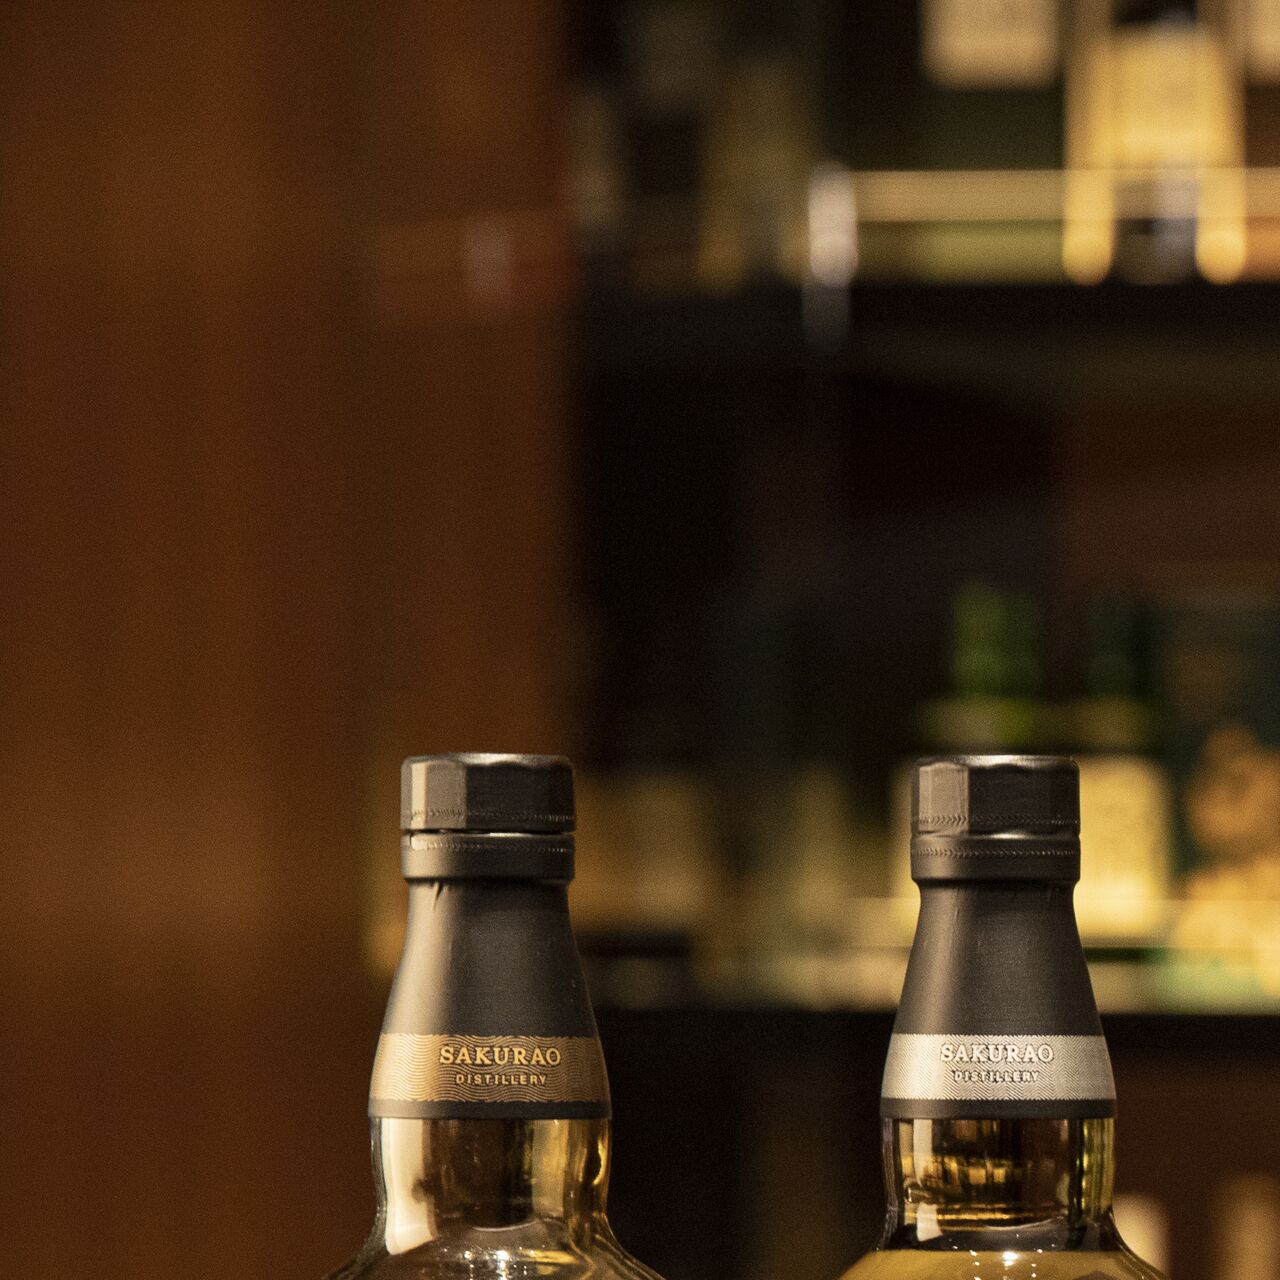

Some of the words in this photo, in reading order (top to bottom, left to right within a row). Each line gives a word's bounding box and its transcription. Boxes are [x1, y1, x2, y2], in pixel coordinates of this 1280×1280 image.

[440, 1046, 561, 1066] SAKURAO
[940, 1043, 1054, 1063] SAKURAO
[456, 1073, 547, 1086] DISTILLERY
[954, 1070, 1039, 1083] DISTILLERY
